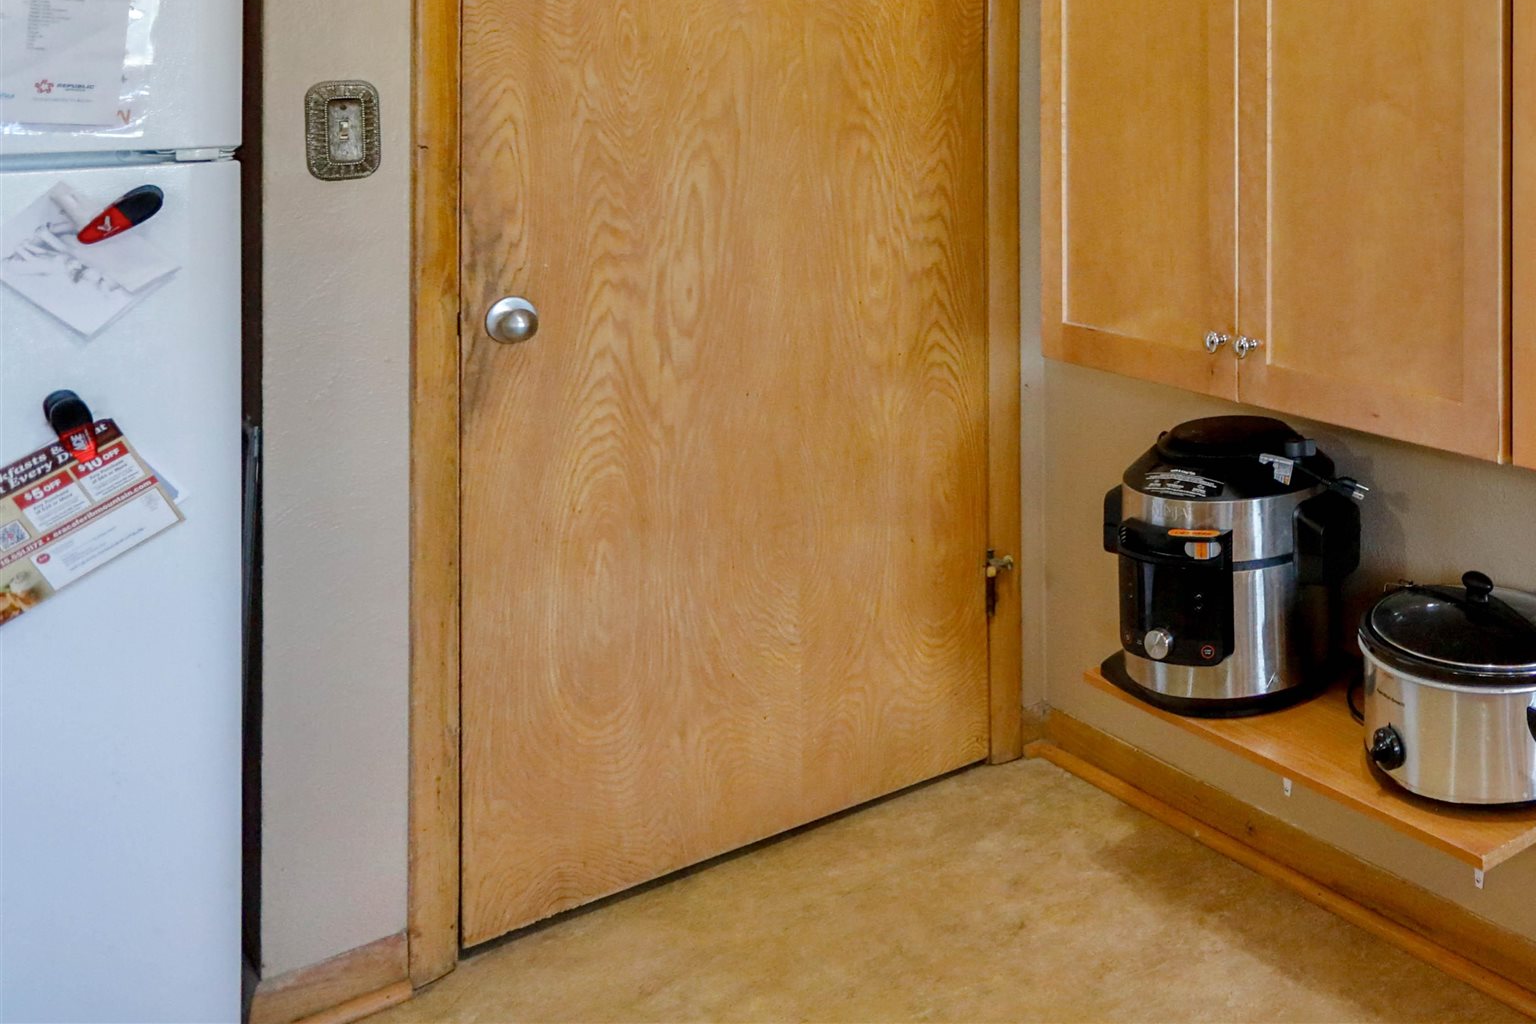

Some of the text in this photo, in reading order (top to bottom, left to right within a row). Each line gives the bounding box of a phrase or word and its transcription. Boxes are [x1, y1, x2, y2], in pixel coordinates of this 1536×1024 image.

[103, 448, 121, 461] OFF
[8, 460, 53, 489] Every
[24, 479, 61, 501] $5 OFF
